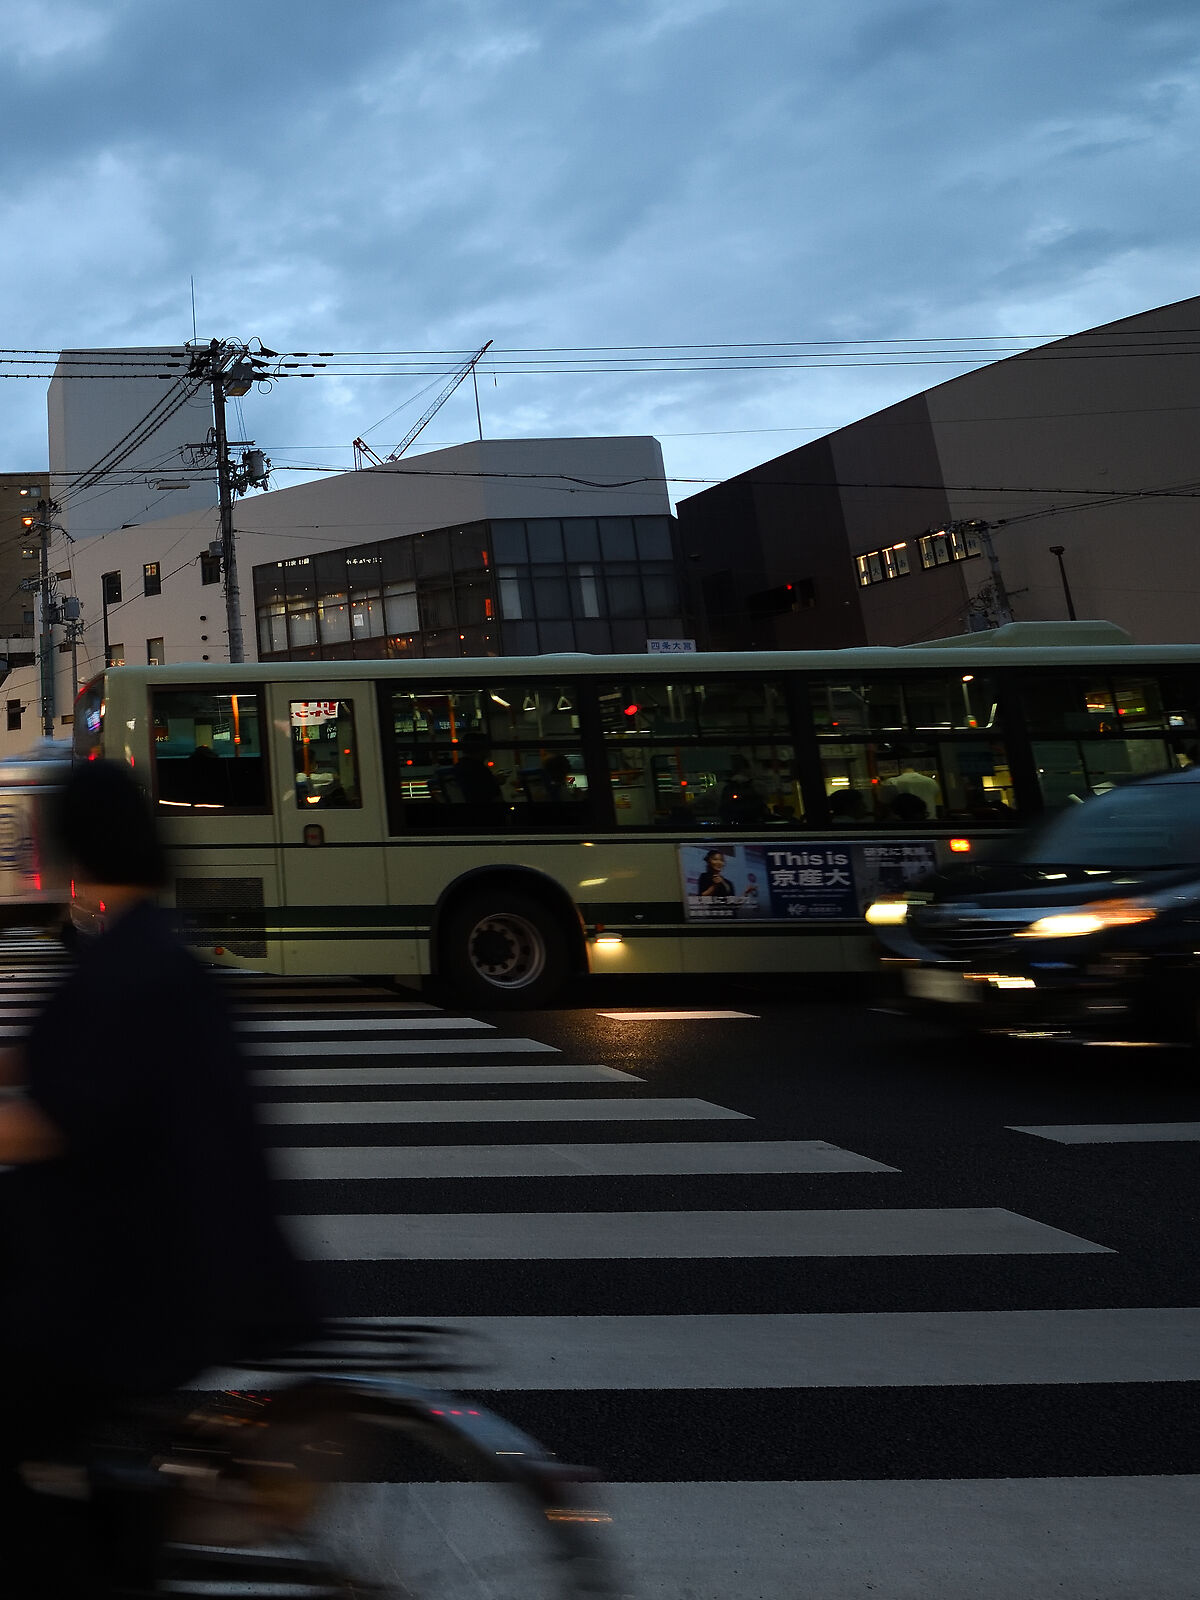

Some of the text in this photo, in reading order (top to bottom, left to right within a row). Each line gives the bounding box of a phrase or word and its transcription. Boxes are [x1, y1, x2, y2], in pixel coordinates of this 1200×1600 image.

[650, 641, 692, 651] 四条大宮
[768, 851, 824, 866] This
[827, 851, 849, 866] is
[771, 868, 851, 887] 京産大
